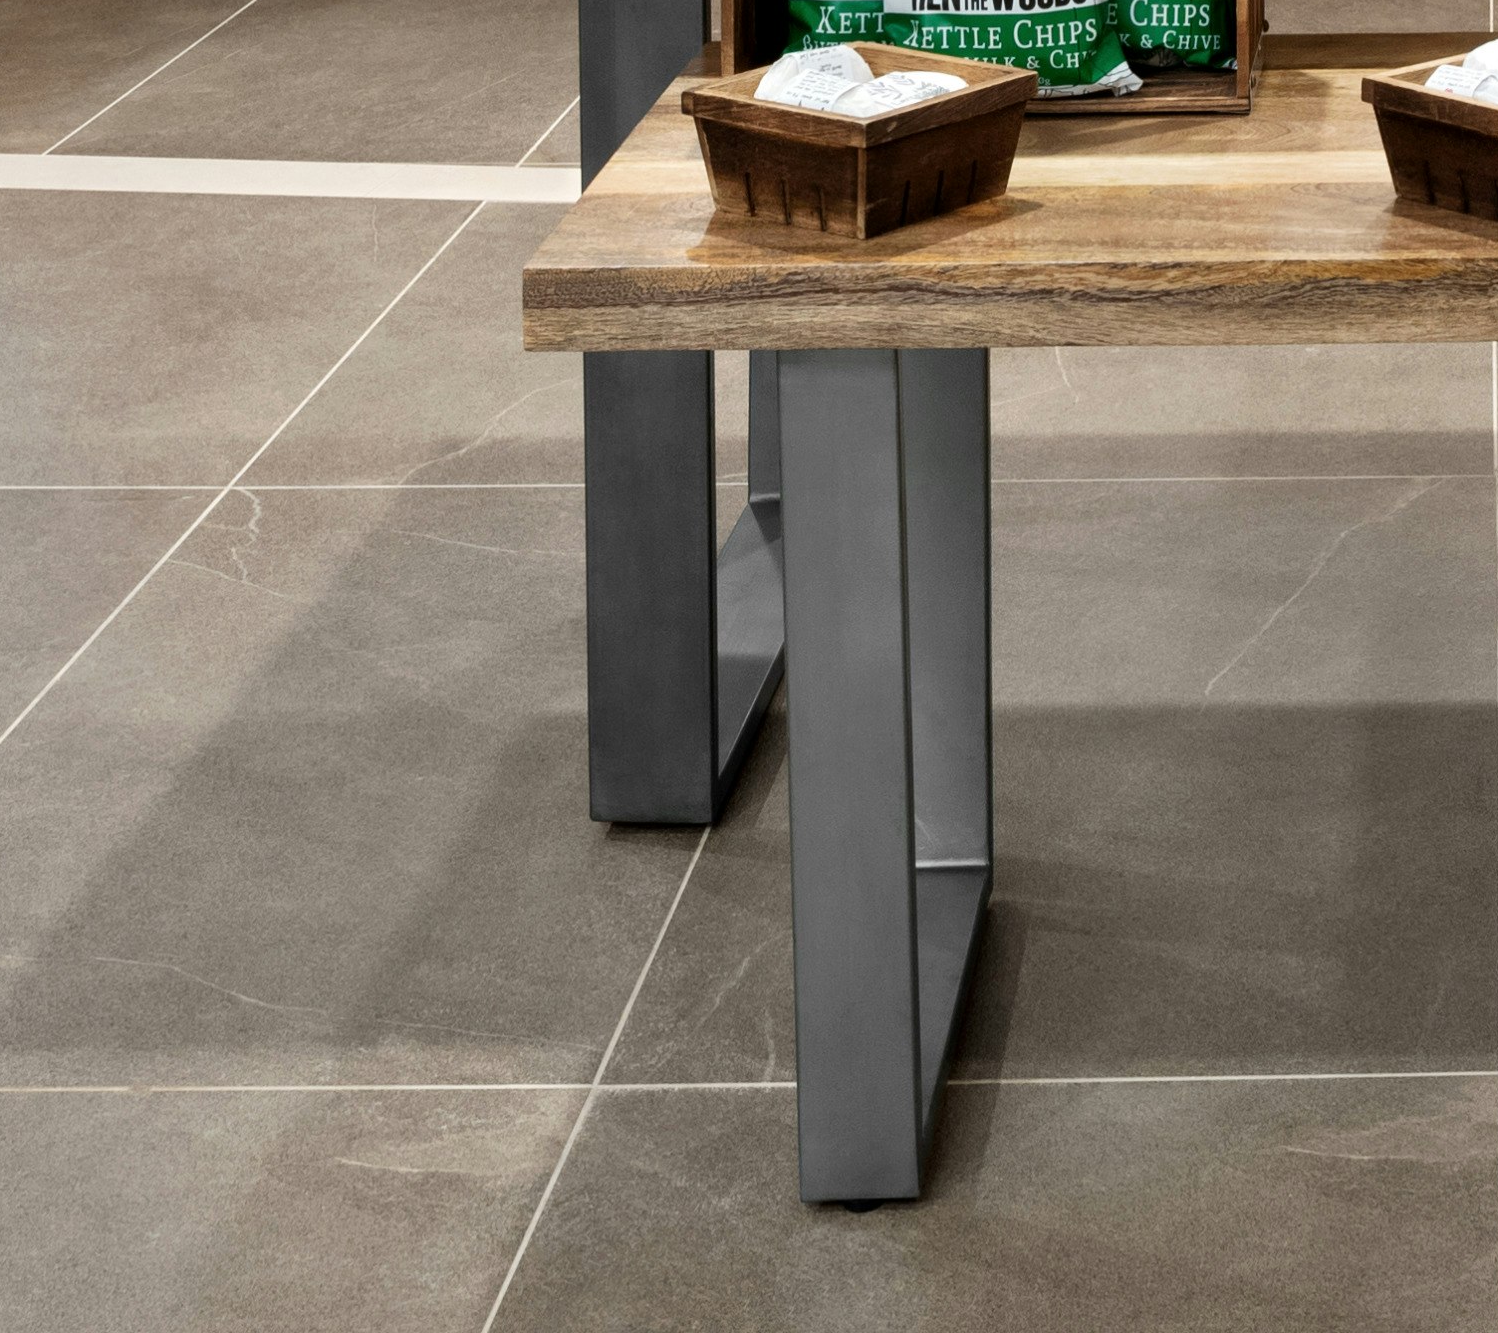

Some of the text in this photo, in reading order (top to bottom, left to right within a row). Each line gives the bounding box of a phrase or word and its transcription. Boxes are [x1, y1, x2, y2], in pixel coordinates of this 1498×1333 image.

[1013, 18, 1097, 49] CHIPS
[1140, 30, 1221, 50] & CHIVE
[1026, 55, 1041, 70] &
